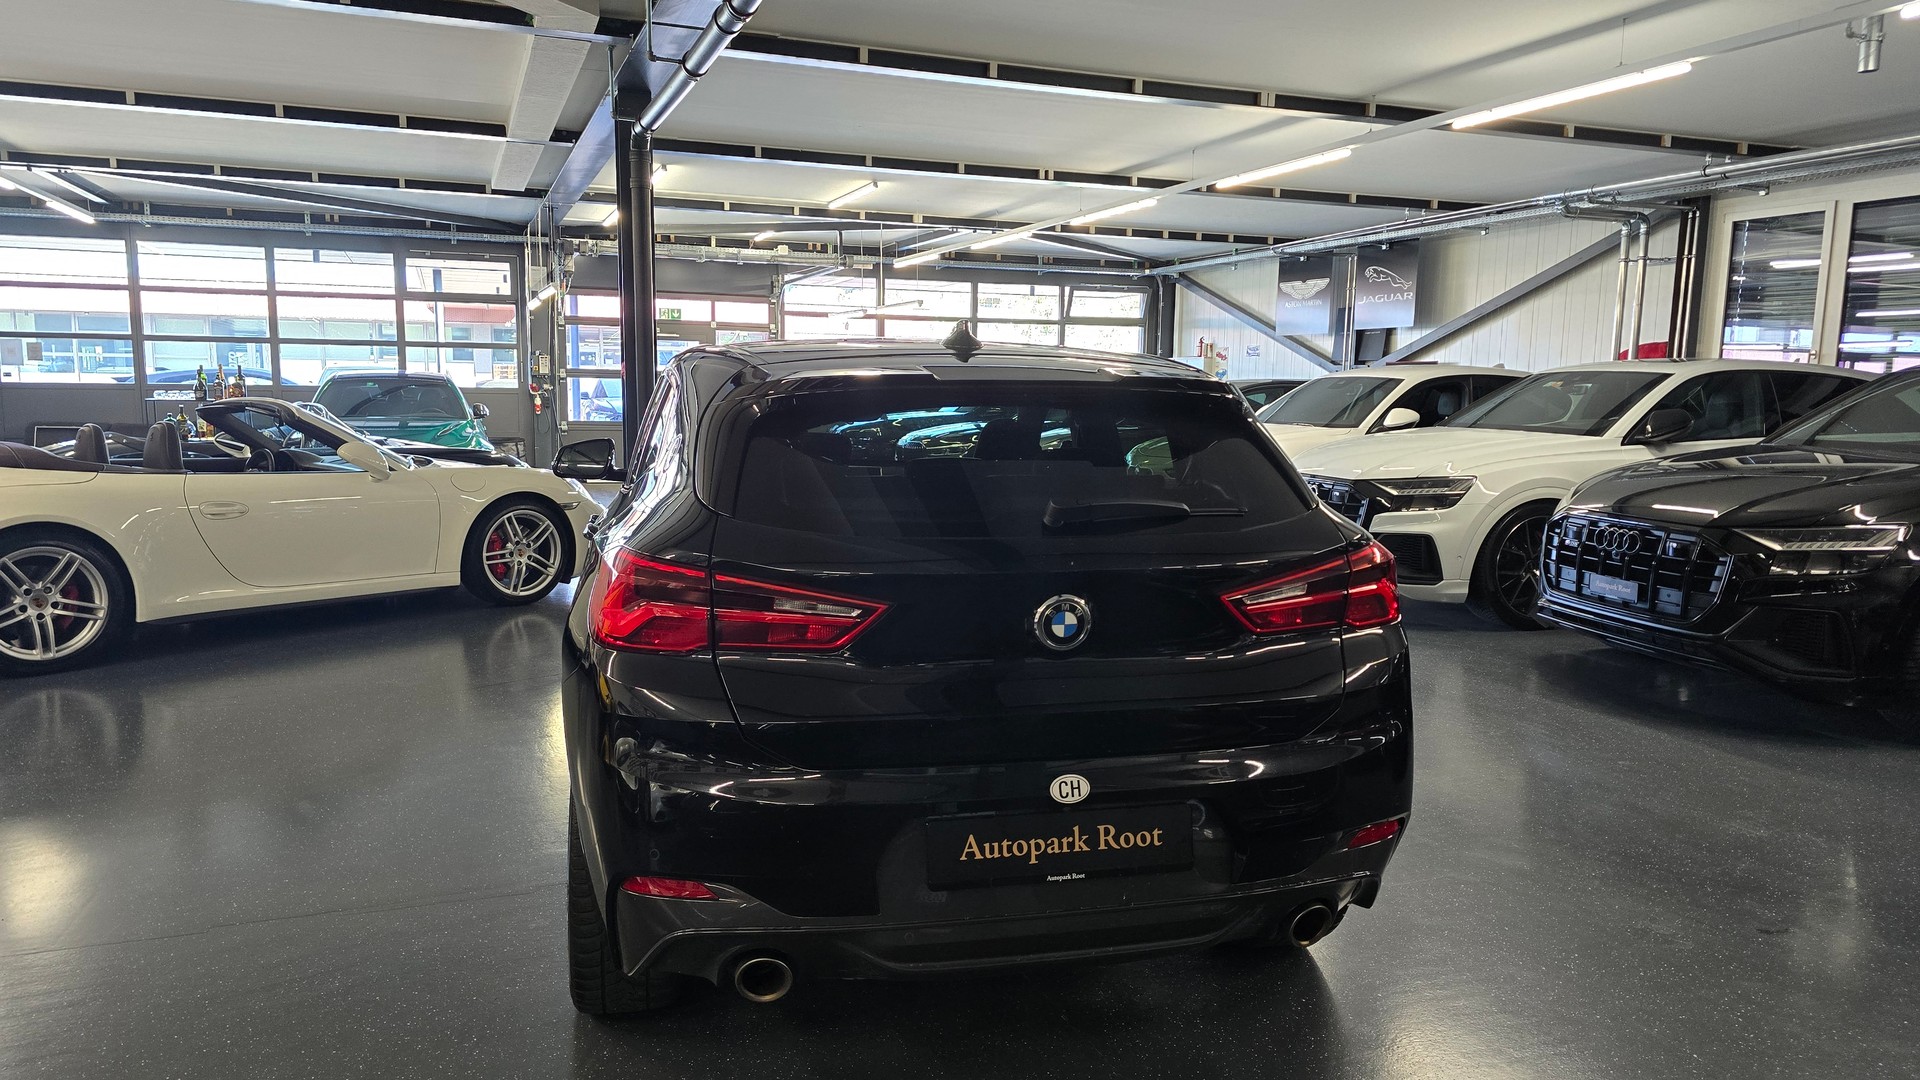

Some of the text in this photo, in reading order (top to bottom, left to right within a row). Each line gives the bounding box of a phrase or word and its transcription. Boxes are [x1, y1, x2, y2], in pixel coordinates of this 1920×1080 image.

[1358, 292, 1413, 304] JAGUAR
[1058, 779, 1082, 799] CH
[959, 824, 1163, 864] Autopark Root
[1046, 872, 1086, 882] Autopark Root
